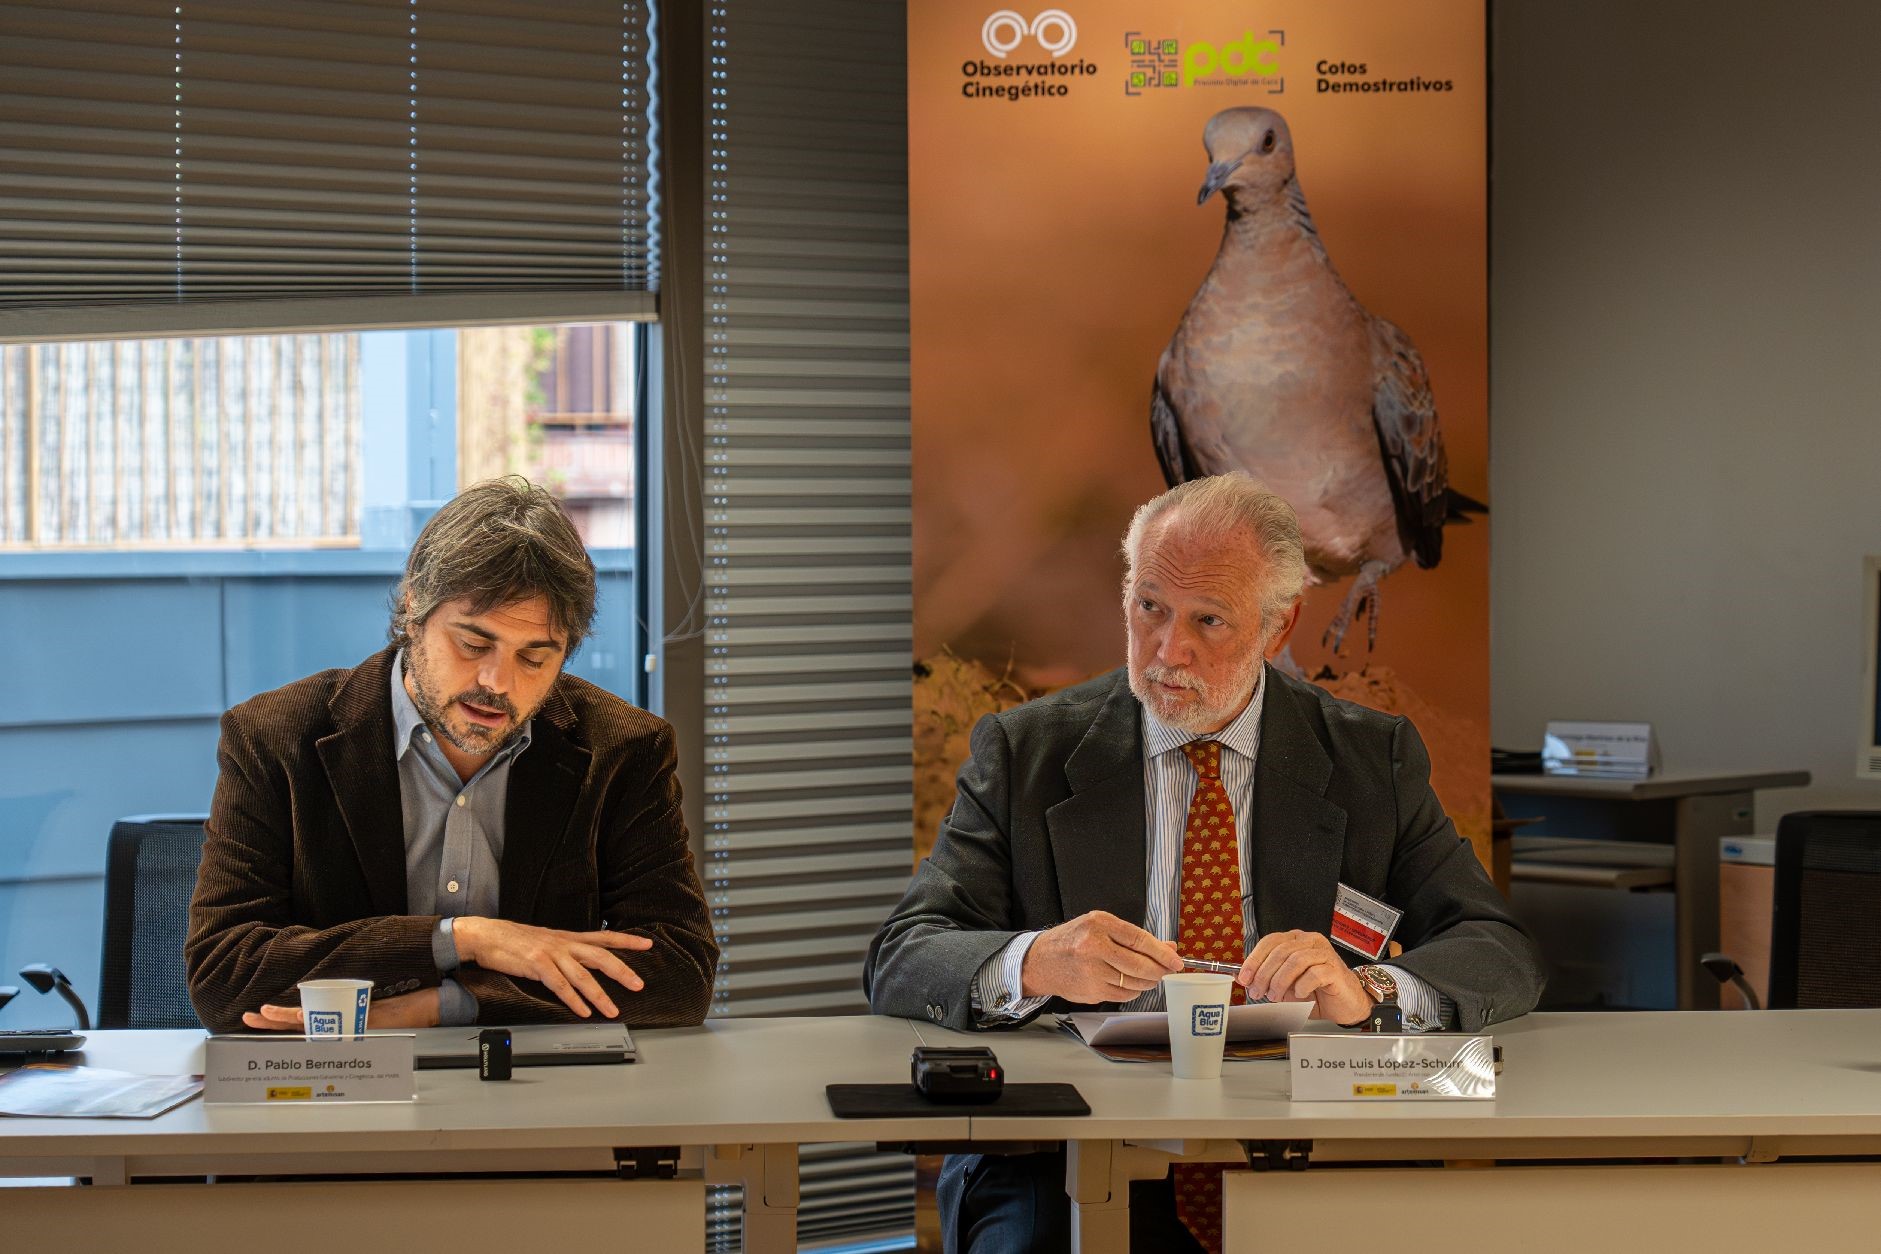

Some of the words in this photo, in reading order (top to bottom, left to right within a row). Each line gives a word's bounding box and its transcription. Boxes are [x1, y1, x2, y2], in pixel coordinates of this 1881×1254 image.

[1184, 30, 1280, 88] pdc
[962, 59, 1097, 77] Observatorio
[1316, 60, 1368, 75] Cotos
[962, 80, 1068, 100] Cinegético
[1317, 77, 1454, 93] Demostrativos
[313, 1016, 336, 1026] Aqua
[1198, 1010, 1220, 1019] Aqua
[315, 1024, 335, 1033] Blue
[1200, 1018, 1219, 1026] Blue
[248, 1060, 261, 1071] D.
[265, 1059, 301, 1071] Pablo
[305, 1058, 372, 1070] Bernardos
[1300, 1058, 1314, 1069] D.
[1317, 1058, 1346, 1070] Jose
[1350, 1058, 1374, 1069] Luis
